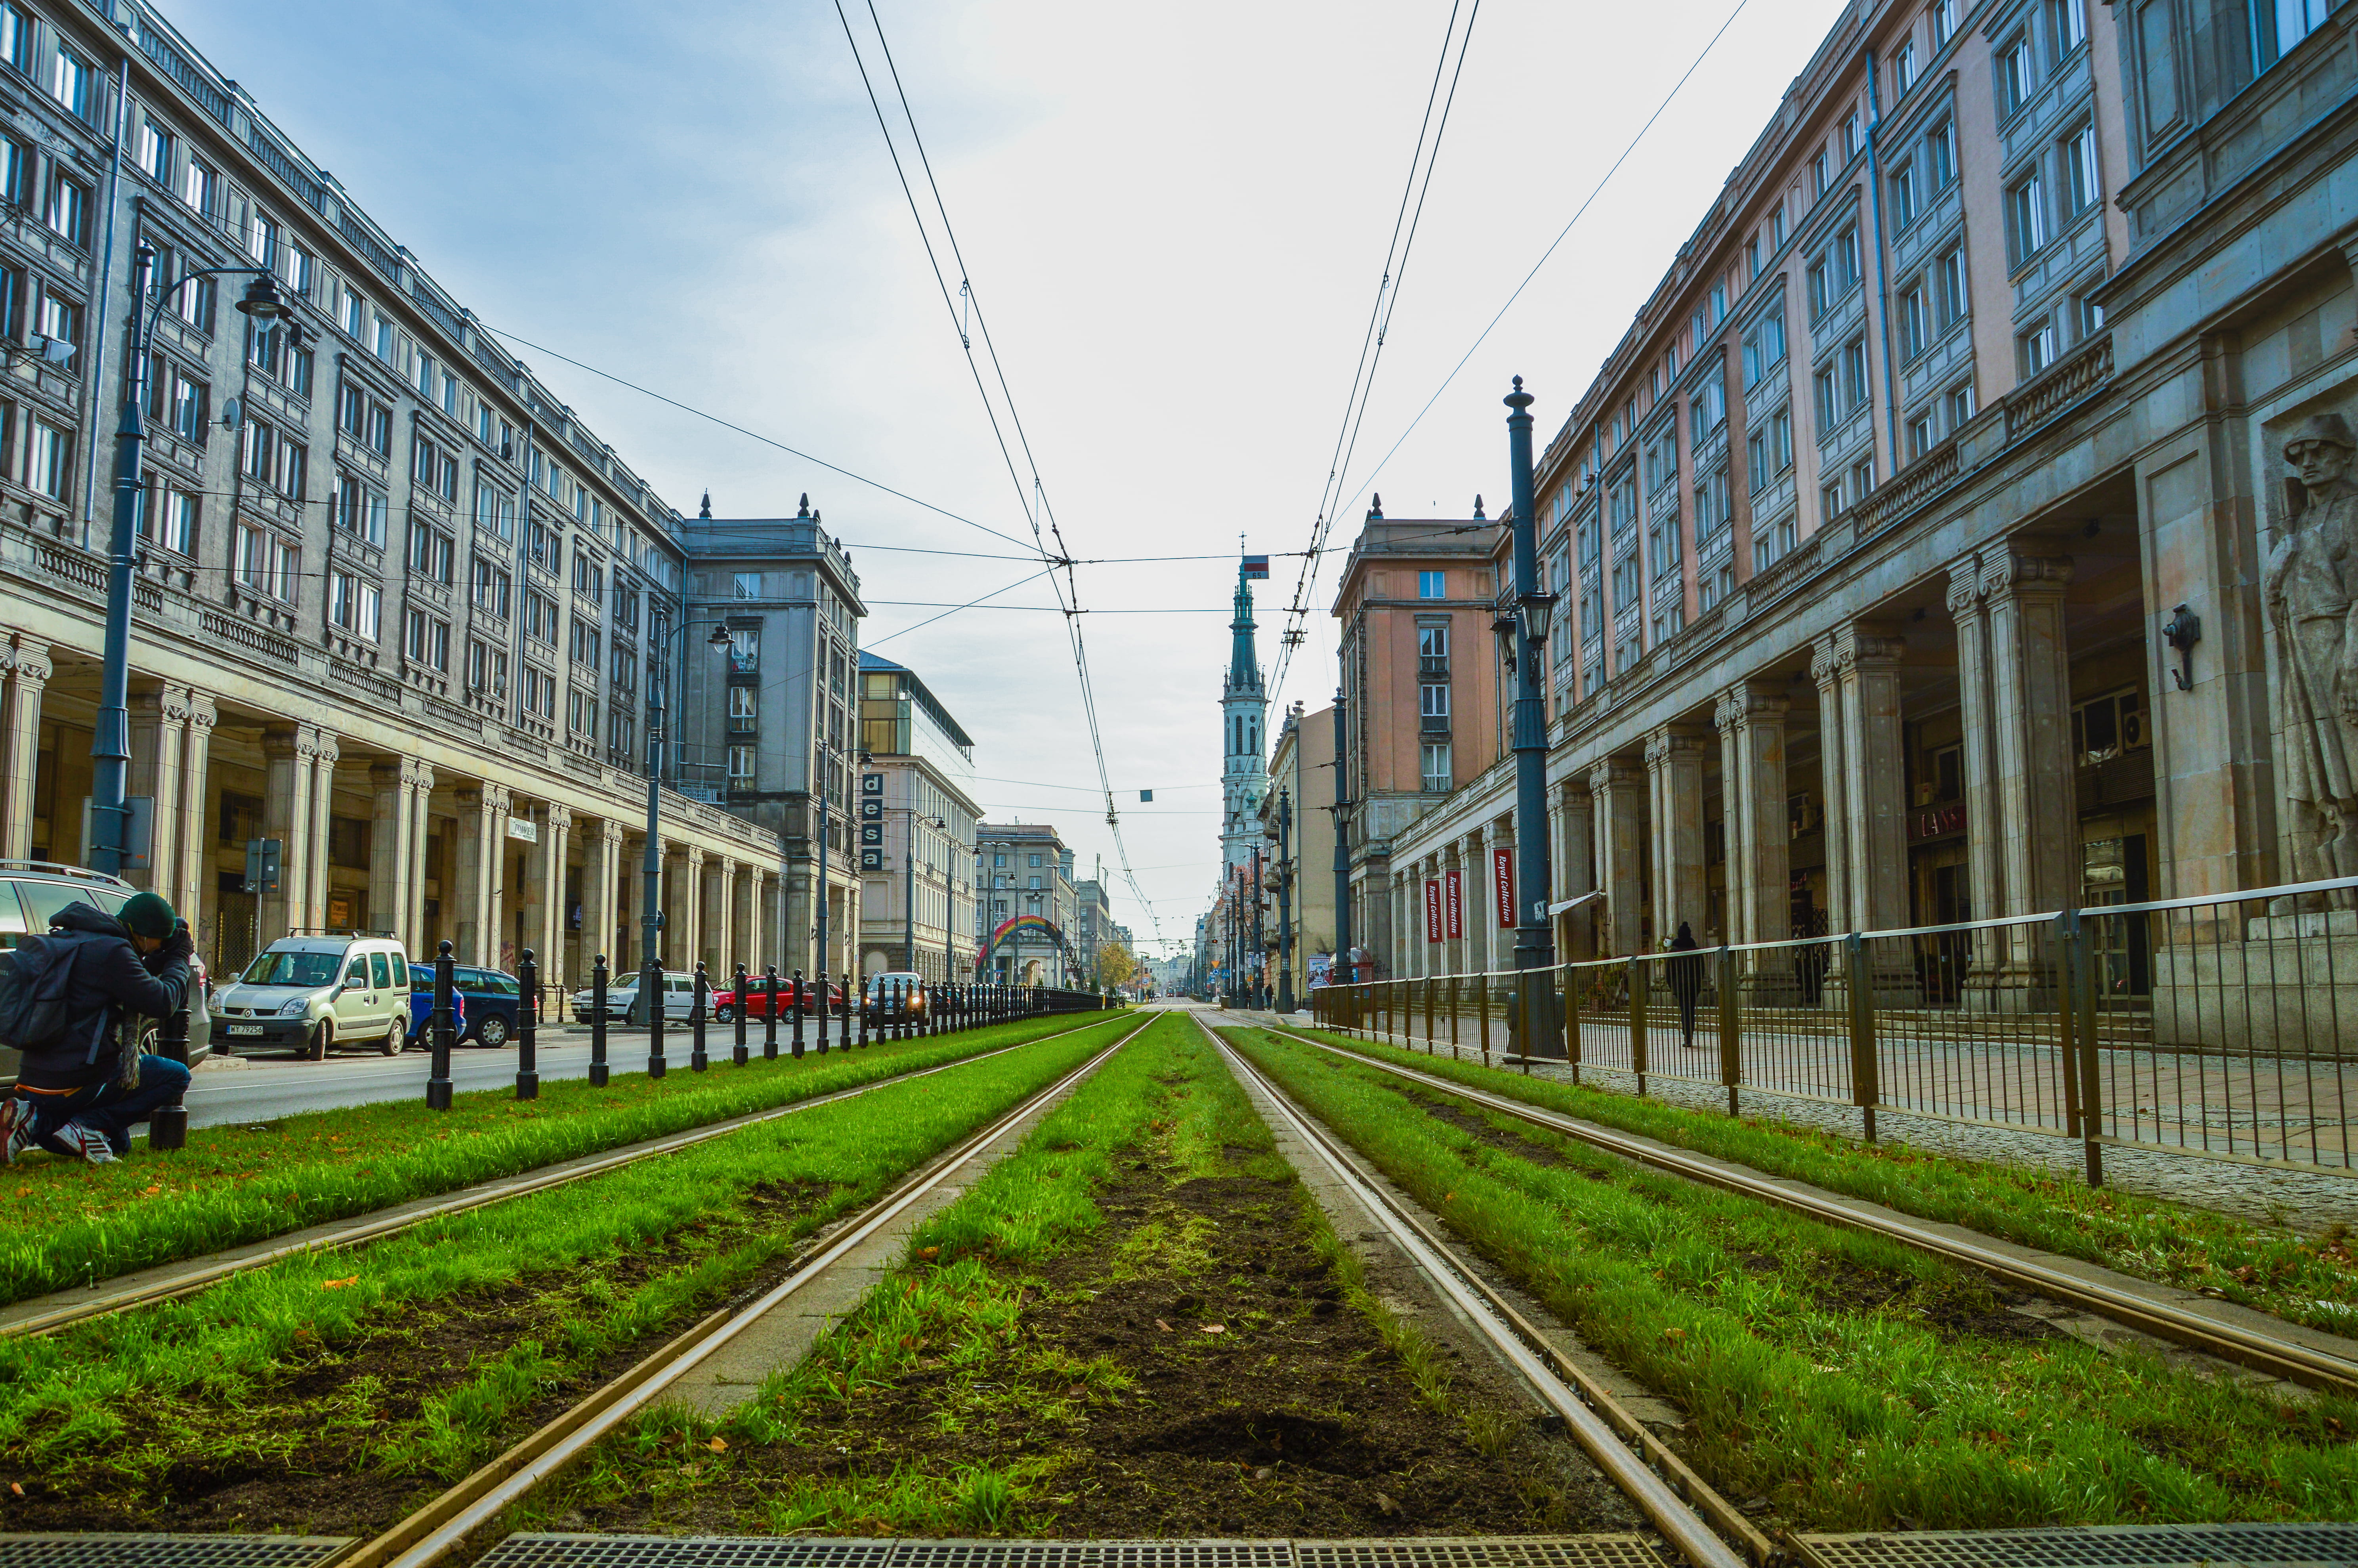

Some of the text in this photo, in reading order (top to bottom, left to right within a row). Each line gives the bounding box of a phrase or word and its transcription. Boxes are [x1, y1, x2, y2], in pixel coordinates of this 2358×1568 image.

[515, 824, 534, 836] TOWER
[864, 776, 878, 864] desa
[1498, 856, 1510, 922] Royal Collection
